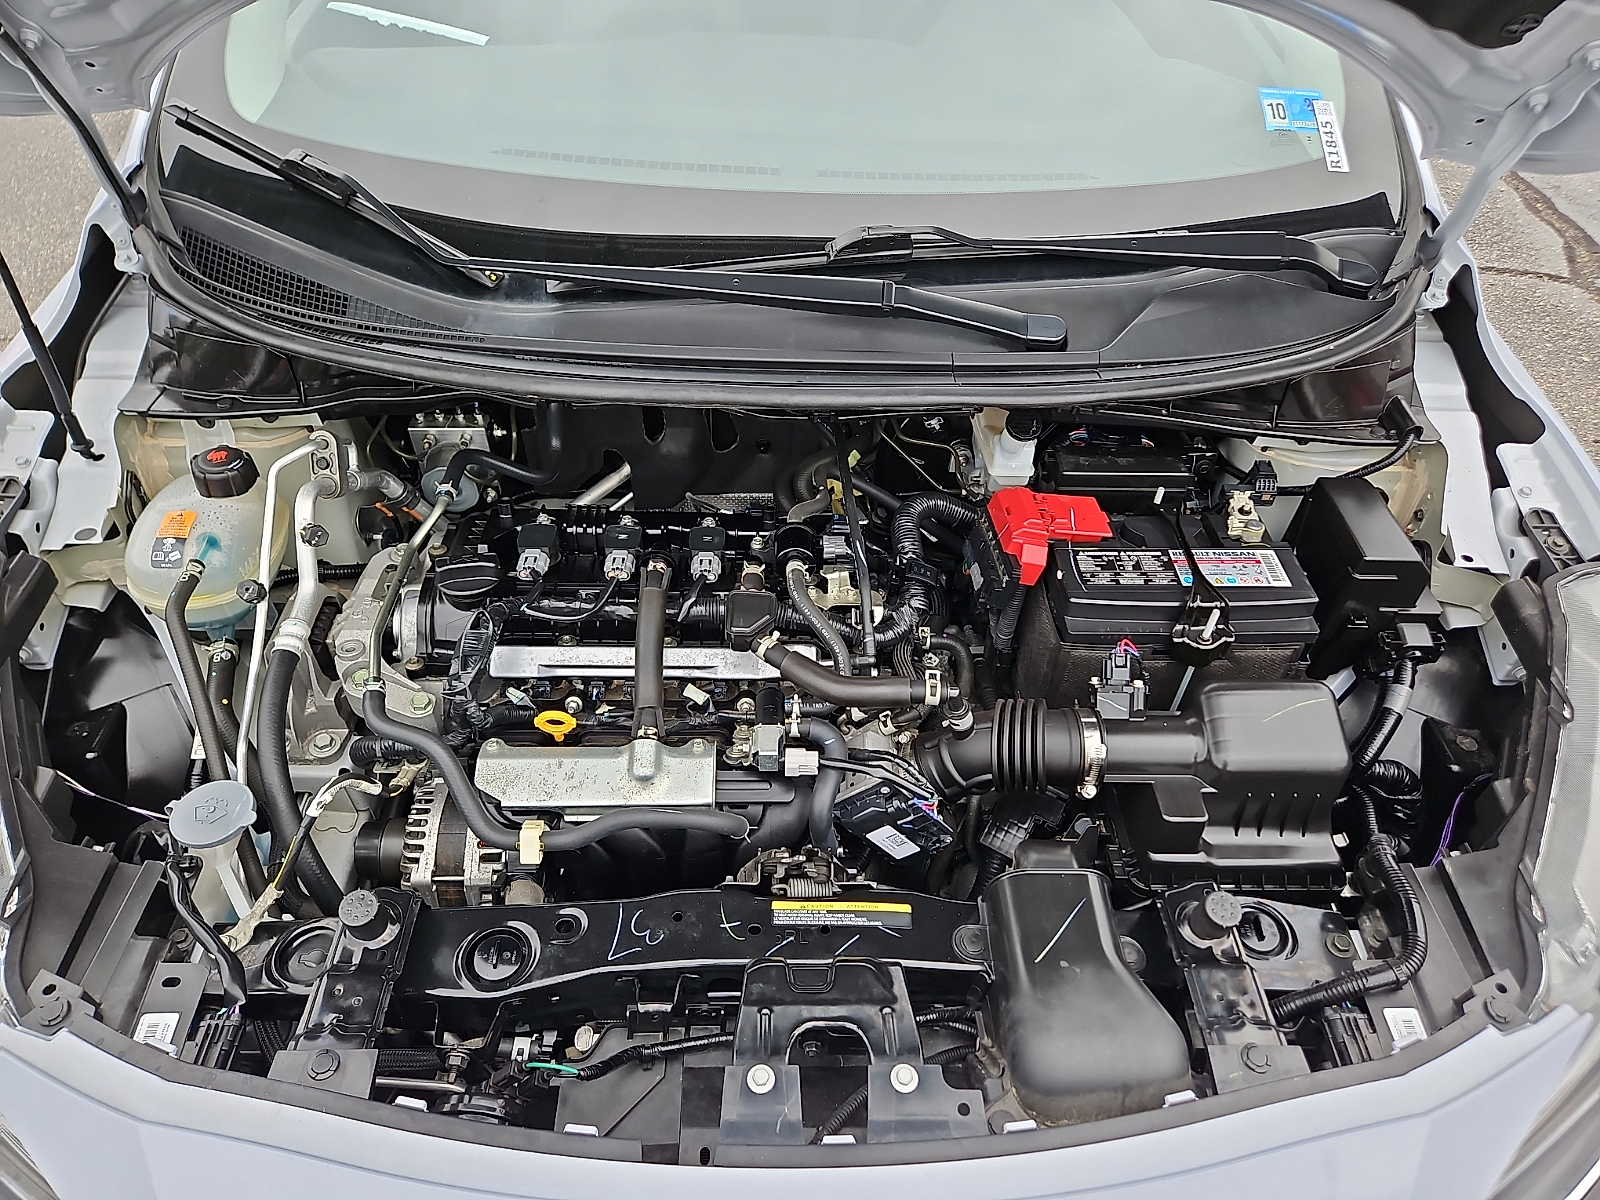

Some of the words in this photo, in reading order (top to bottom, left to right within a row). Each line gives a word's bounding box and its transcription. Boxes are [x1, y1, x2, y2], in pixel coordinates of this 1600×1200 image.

[1266, 102, 1287, 120] 10
[1320, 120, 1342, 169] R1845
[180, 572, 190, 581] B
